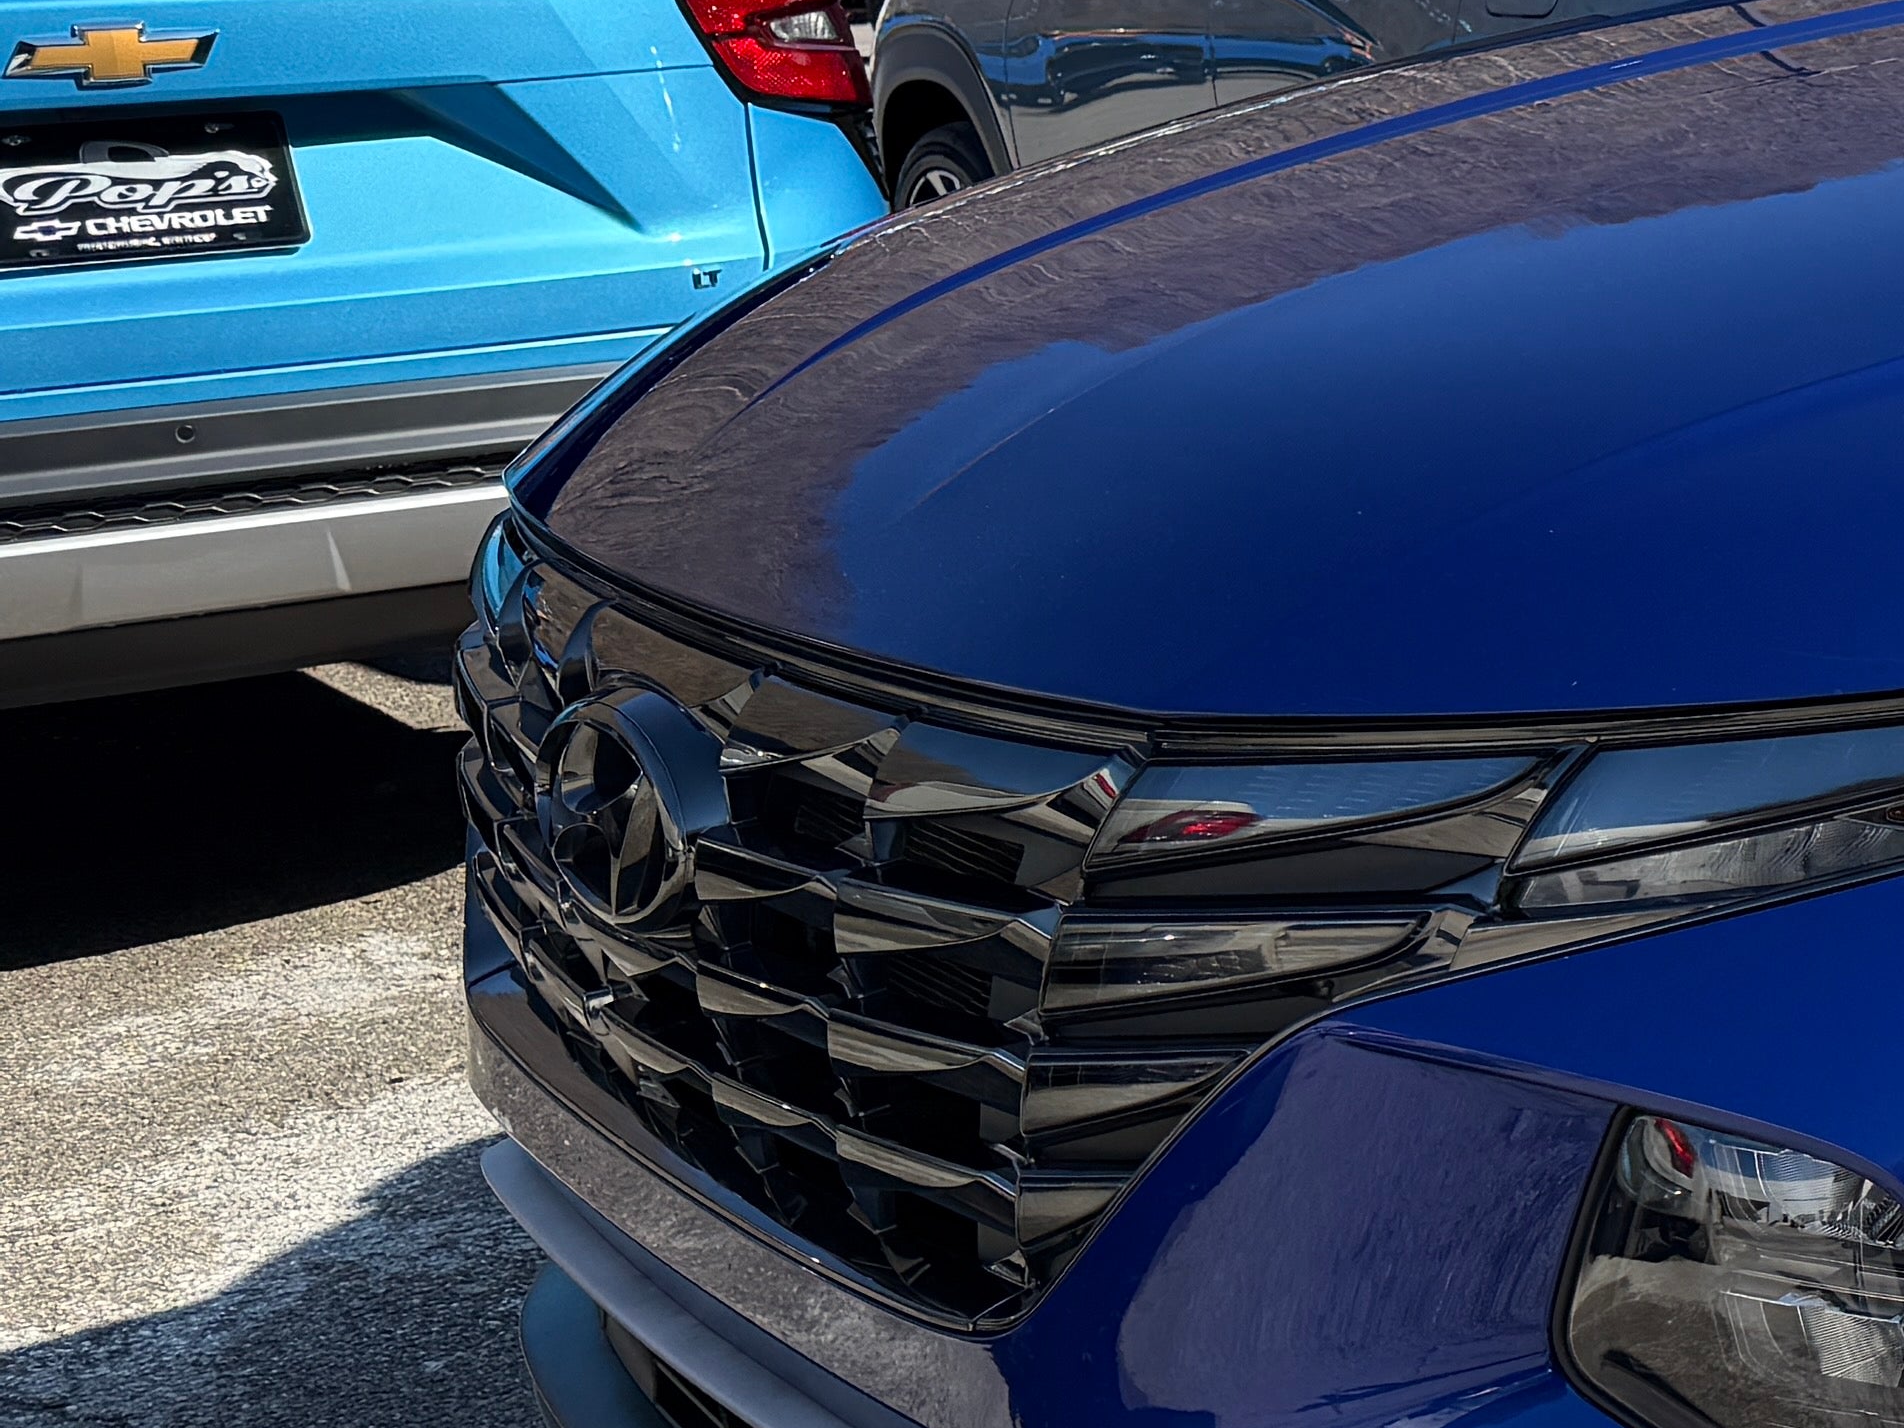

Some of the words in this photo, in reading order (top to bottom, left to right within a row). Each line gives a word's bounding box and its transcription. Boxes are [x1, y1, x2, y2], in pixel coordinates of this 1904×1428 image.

[12, 169, 262, 210] Pop's
[86, 205, 274, 236] CHEVROLET
[692, 268, 723, 290] LT
